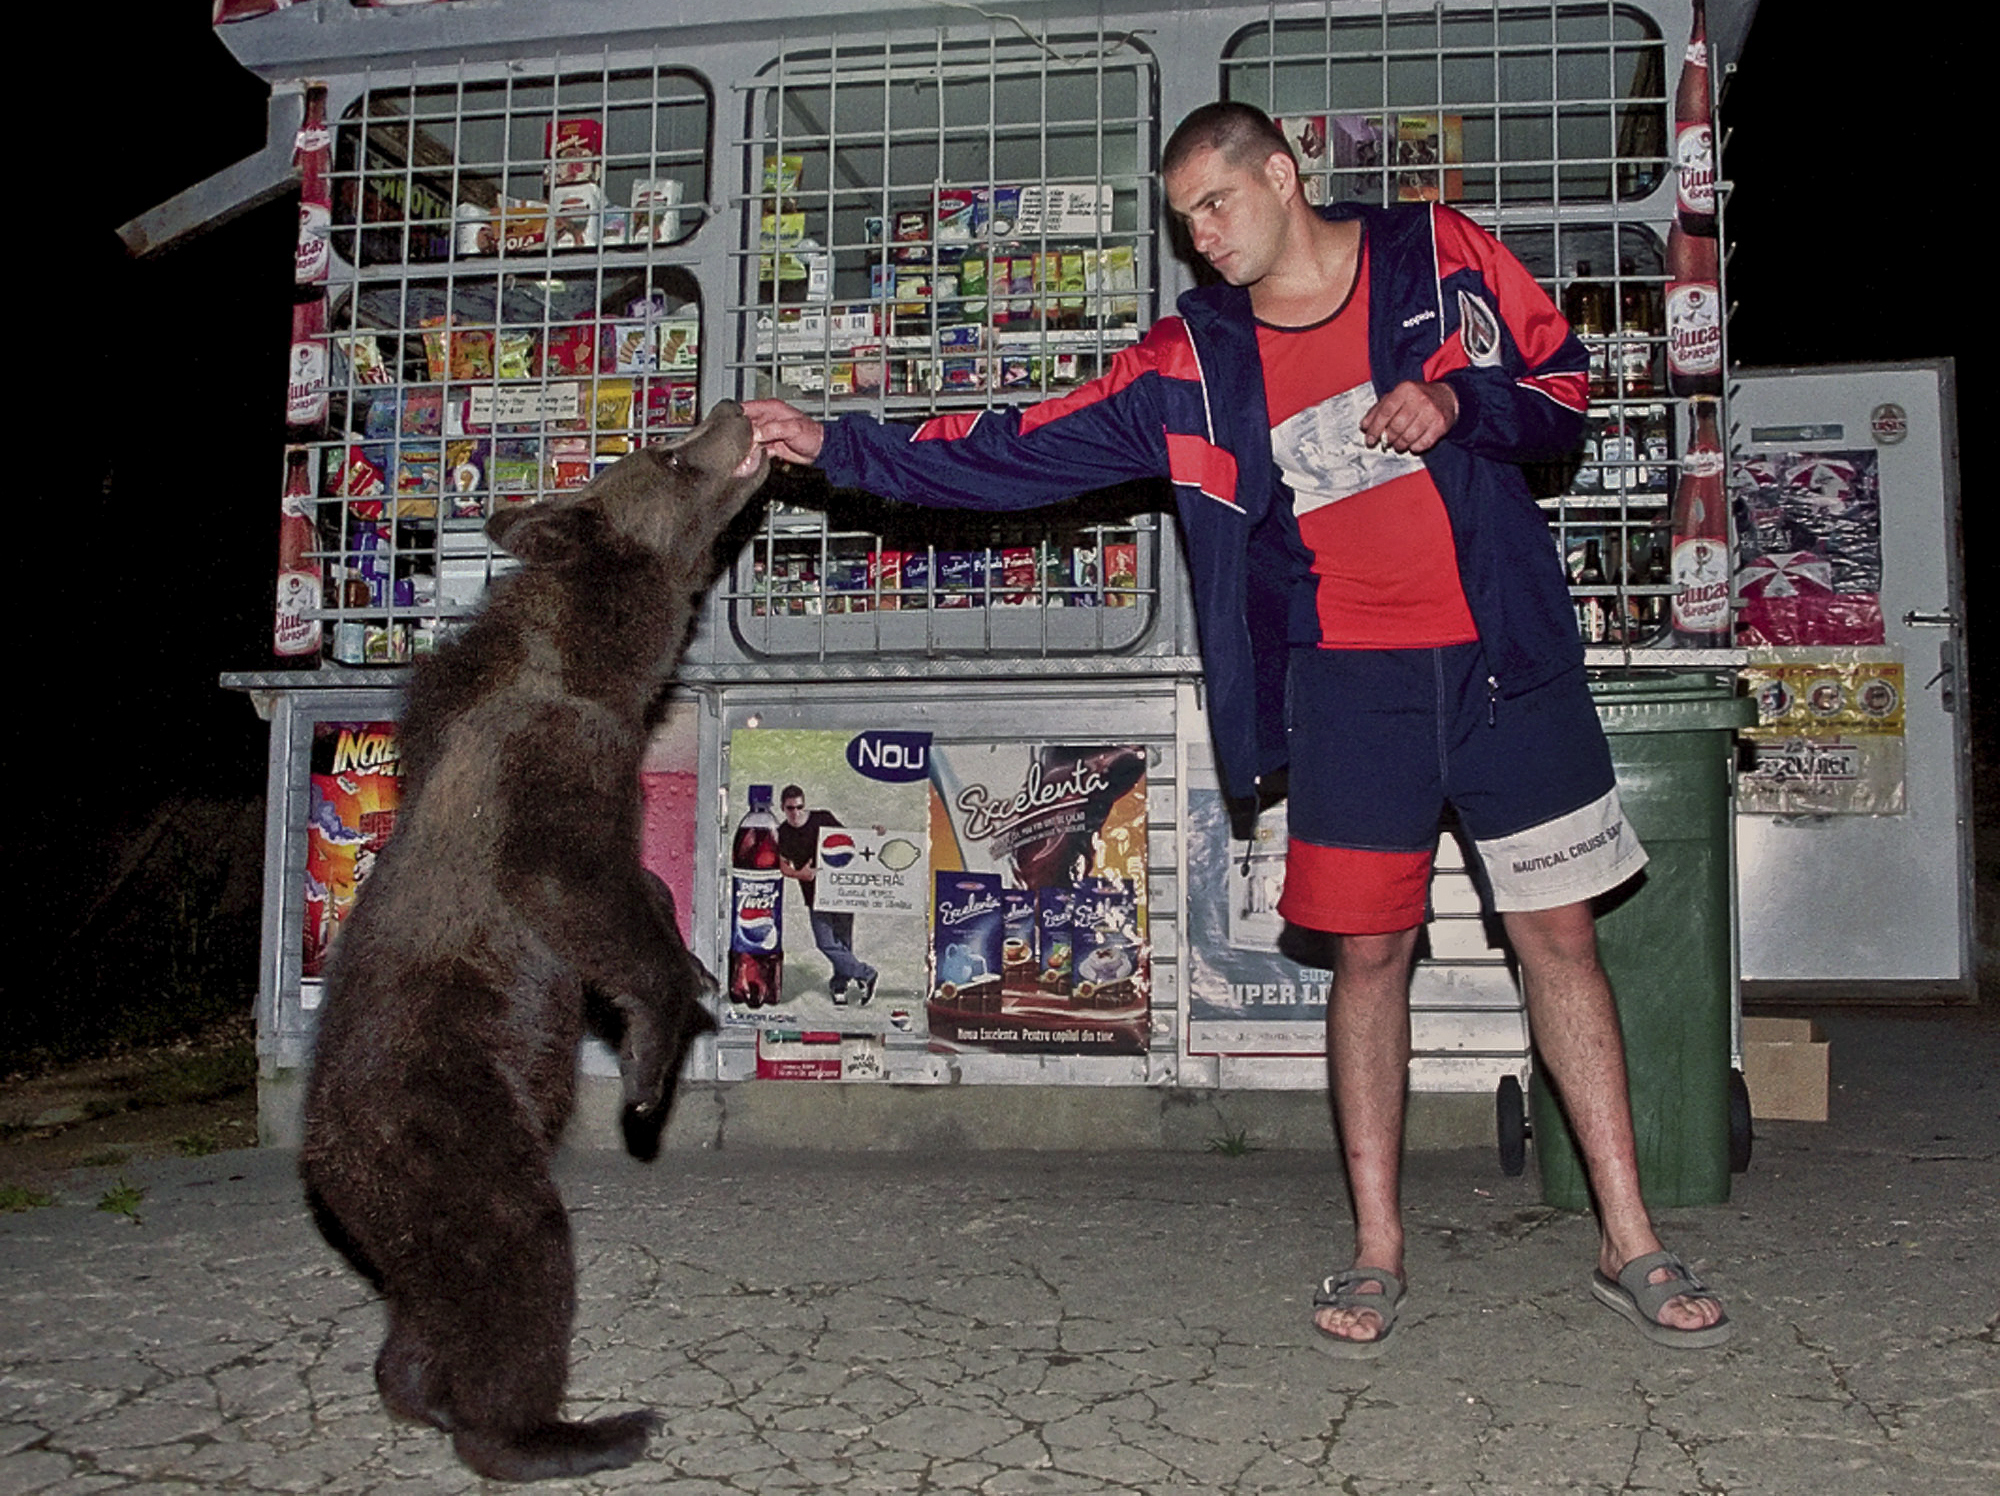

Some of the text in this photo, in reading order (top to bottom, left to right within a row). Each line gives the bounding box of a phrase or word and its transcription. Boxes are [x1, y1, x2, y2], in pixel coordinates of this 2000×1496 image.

[1871, 420, 1906, 431] URSUS
[332, 729, 400, 774] INCRE
[858, 738, 925, 770] Nou
[957, 758, 1110, 840] Excelenta
[1512, 851, 1569, 874] NAUTICAL
[1568, 831, 1608, 859] CRUISE
[1300, 968, 1334, 983] SUP
[1227, 983, 1297, 1006] UPER
